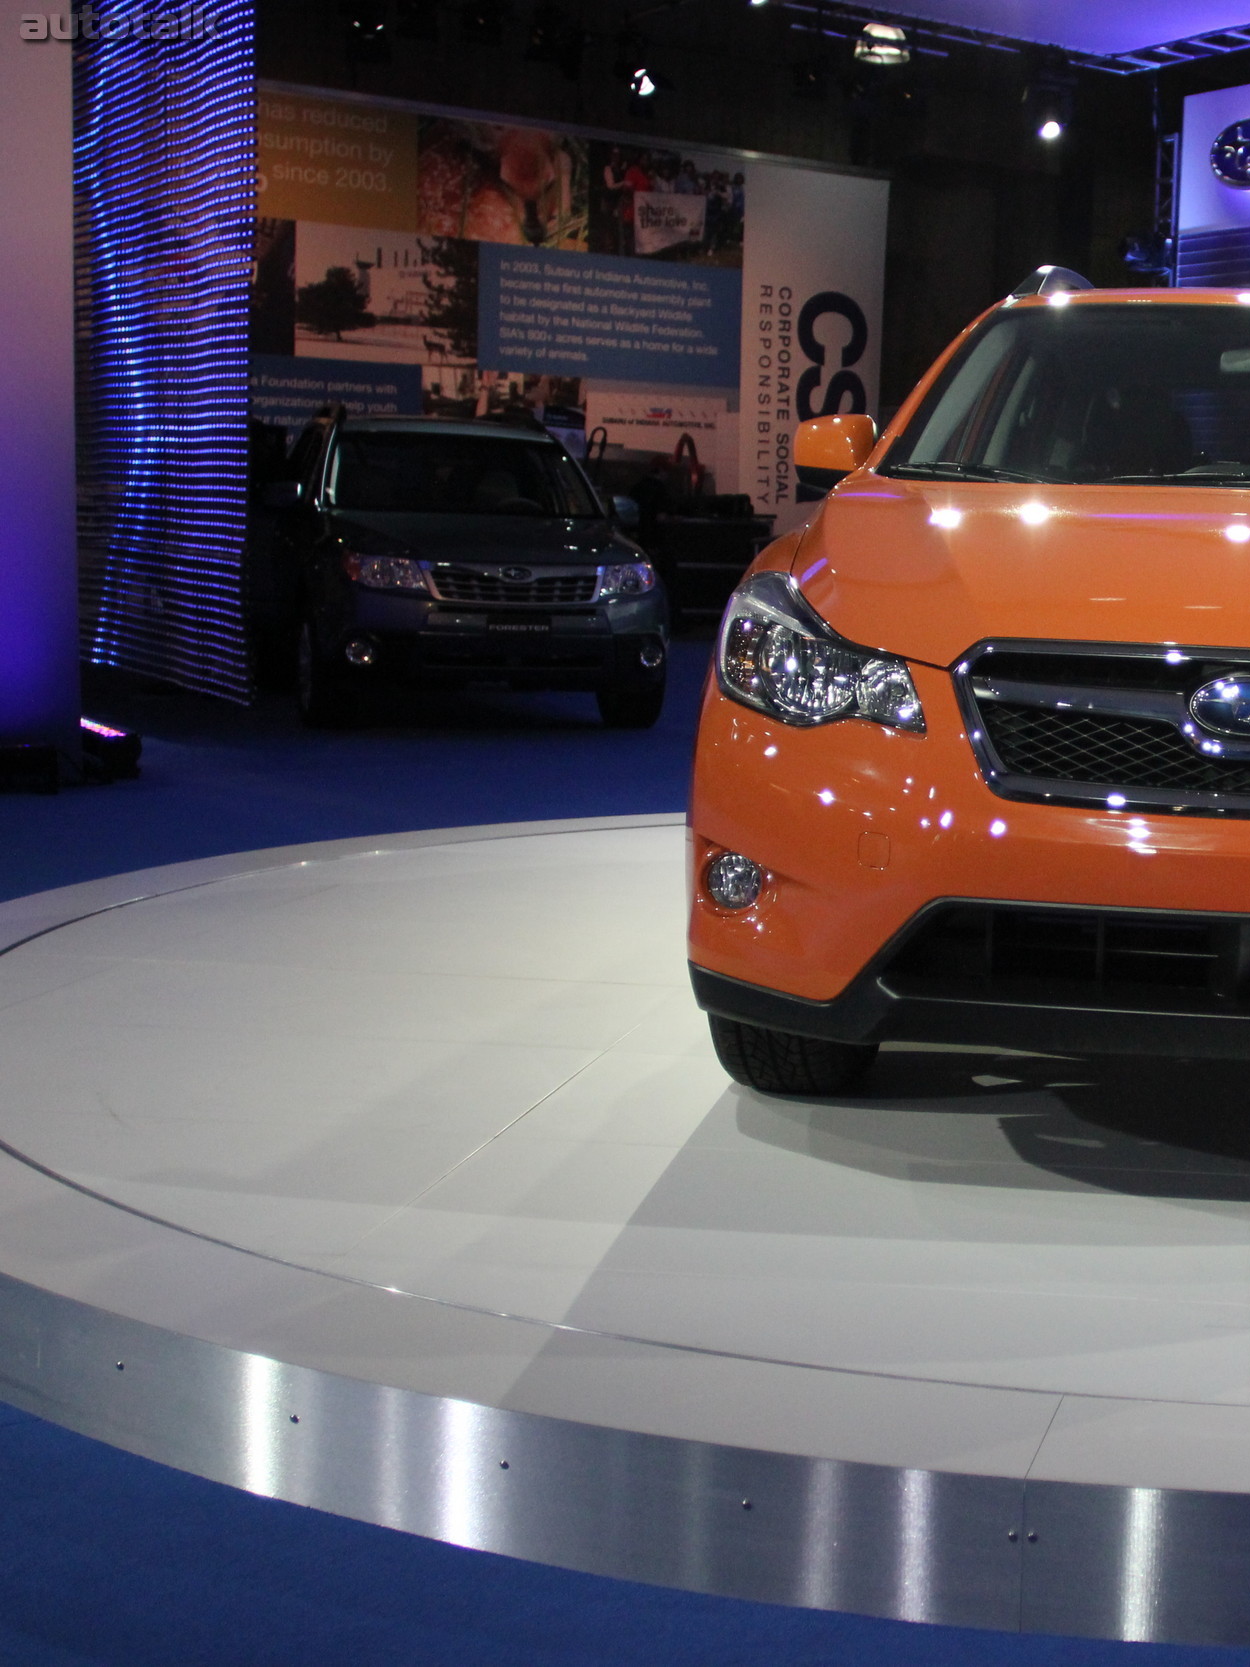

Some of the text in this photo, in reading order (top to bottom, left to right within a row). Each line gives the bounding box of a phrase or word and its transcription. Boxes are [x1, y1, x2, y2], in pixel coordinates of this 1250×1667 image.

[303, 106, 388, 133] reduced
[369, 142, 395, 168] by
[271, 161, 329, 185] since
[336, 167, 393, 192] 2003.
[544, 263, 580, 278] Subaru
[582, 269, 594, 279] of
[595, 269, 632, 284] Indiana
[499, 294, 511, 305] to
[512, 294, 527, 306] be
[543, 281, 560, 292] the
[583, 286, 639, 301] automotive
[537, 313, 552, 327] by
[552, 315, 569, 327] the
[571, 316, 613, 331] National
[534, 346, 547, 358] of
[671, 342, 685, 353] for
[260, 373, 325, 389] Foundation
[327, 380, 373, 396] partners
[375, 383, 398, 395] with
[756, 284, 774, 505] RESPONSIBILITY
[774, 286, 793, 505] CORPORATE SOCIAL
[795, 290, 868, 504] CS
[368, 401, 398, 413] youth
[488, 623, 549, 632] FORESTER
